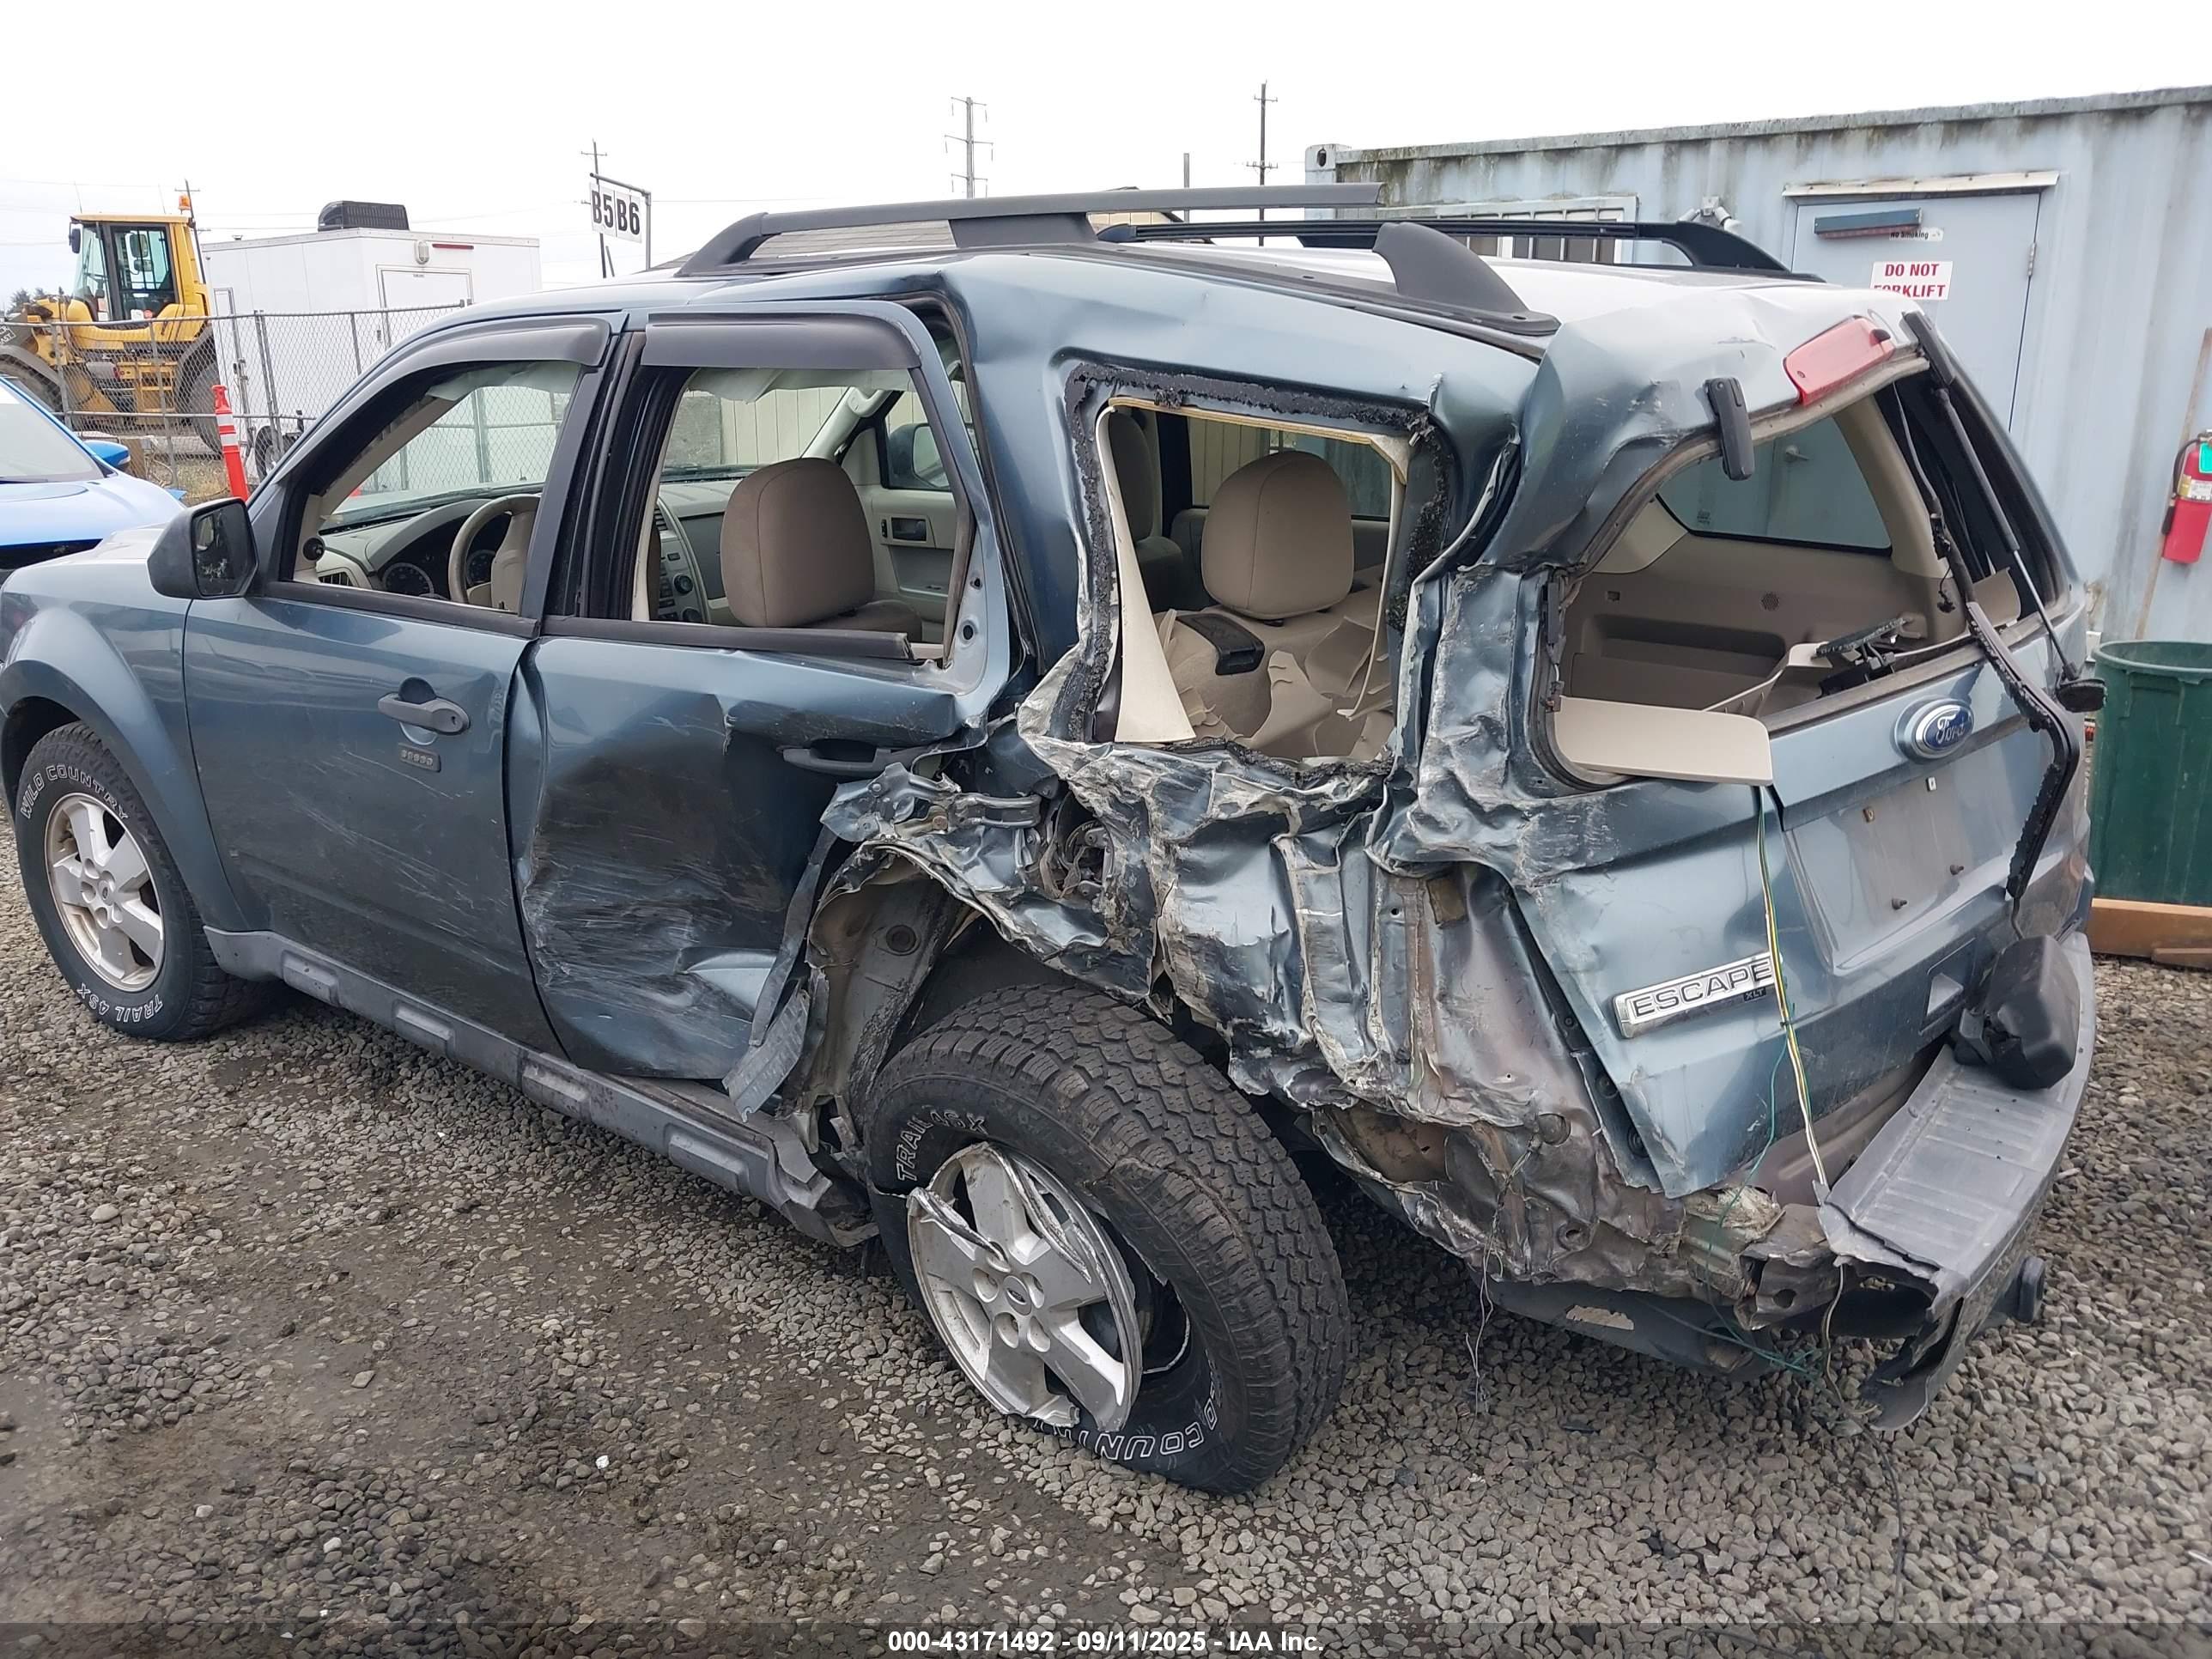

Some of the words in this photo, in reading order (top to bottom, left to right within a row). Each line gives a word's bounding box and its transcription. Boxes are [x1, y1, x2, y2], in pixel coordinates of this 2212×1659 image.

[592, 190, 614, 228] B5
[617, 198, 641, 235] B6
[1885, 264, 1905, 276] DO
[1910, 264, 1940, 276] NOT
[1936, 713, 1966, 744] Ford
[20, 772, 45, 819] WILD
[46, 763, 129, 819] COUNTRY
[1633, 958, 1772, 1017] ESCAPE
[1745, 988, 1765, 1001] XLT
[115, 994, 163, 1023] TRAIL
[896, 1115, 934, 1182] TRAIL
